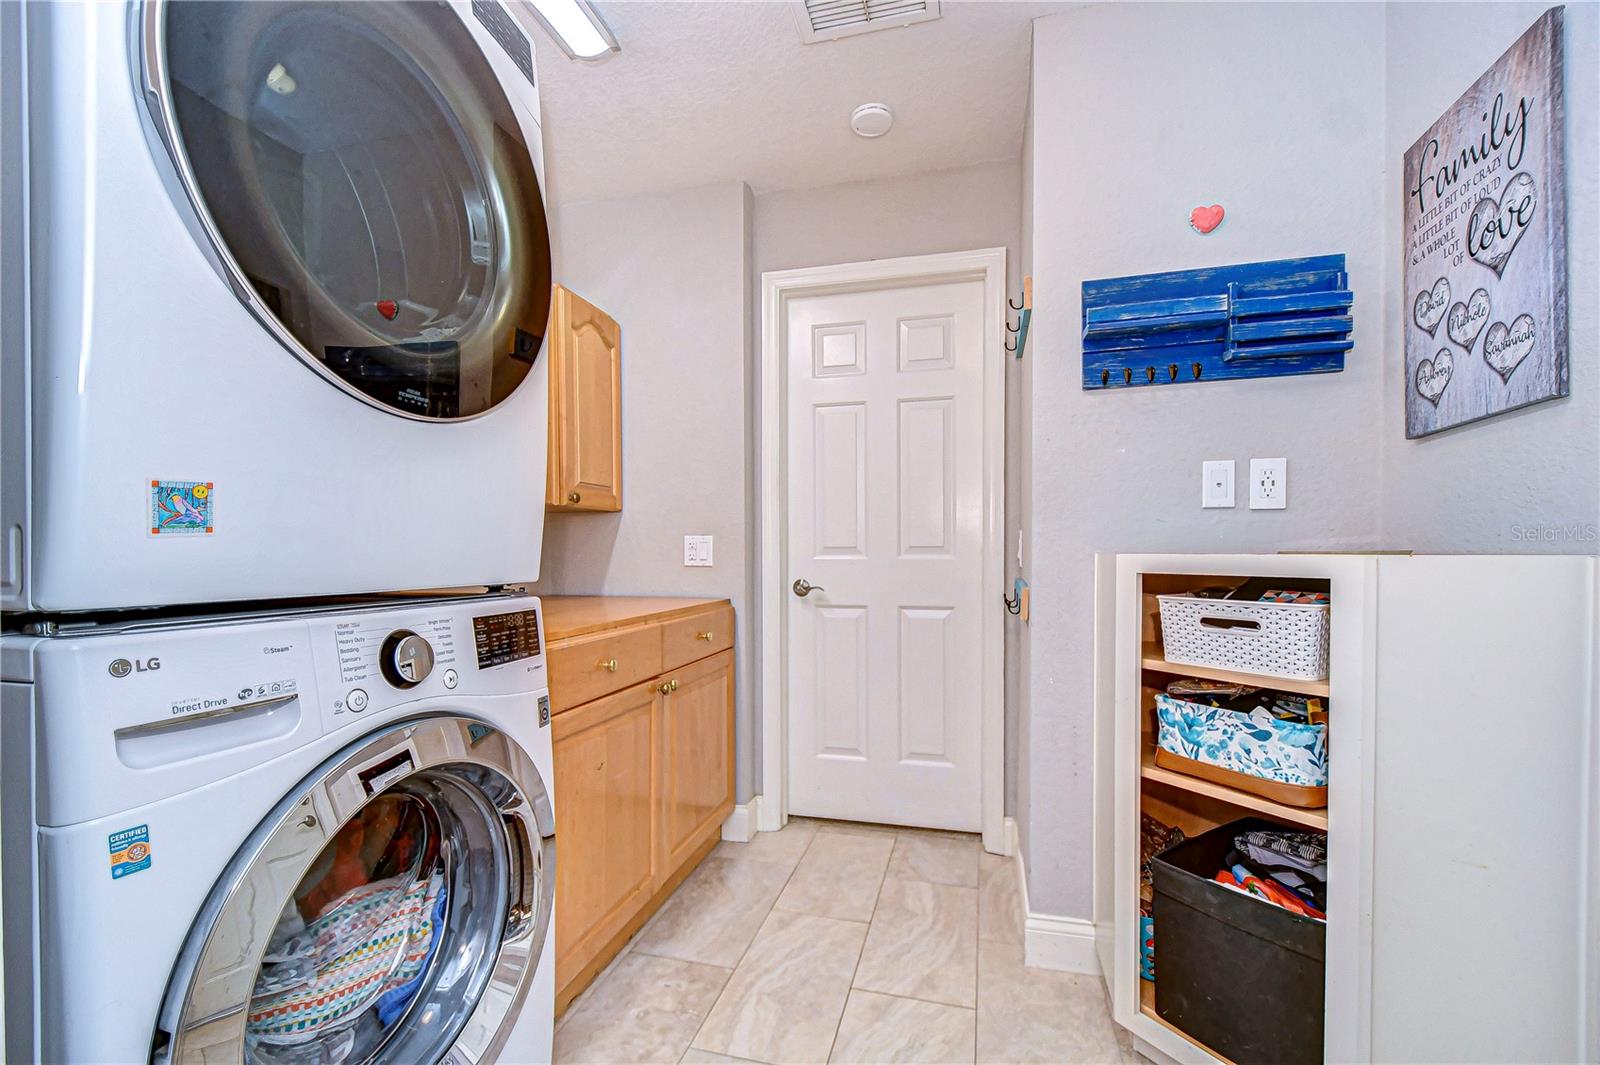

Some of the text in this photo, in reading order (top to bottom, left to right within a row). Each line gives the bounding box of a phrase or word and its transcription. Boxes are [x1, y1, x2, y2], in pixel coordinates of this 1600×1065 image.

[1411, 92, 1535, 213] family
[1413, 153, 1503, 234] A LITTLE BIT OF CRAZY
[1413, 176, 1501, 249] A LITTLE BIT OF LOUD
[1467, 194, 1531, 258] love
[1411, 227, 1456, 266] & A WHOLE
[1443, 239, 1461, 259] LOT
[1453, 251, 1465, 267] OF
[1484, 326, 1535, 360] Savannah
[135, 657, 161, 673] LG
[172, 698, 228, 715] Direct Drive
[110, 827, 148, 843] CERTIFIED
